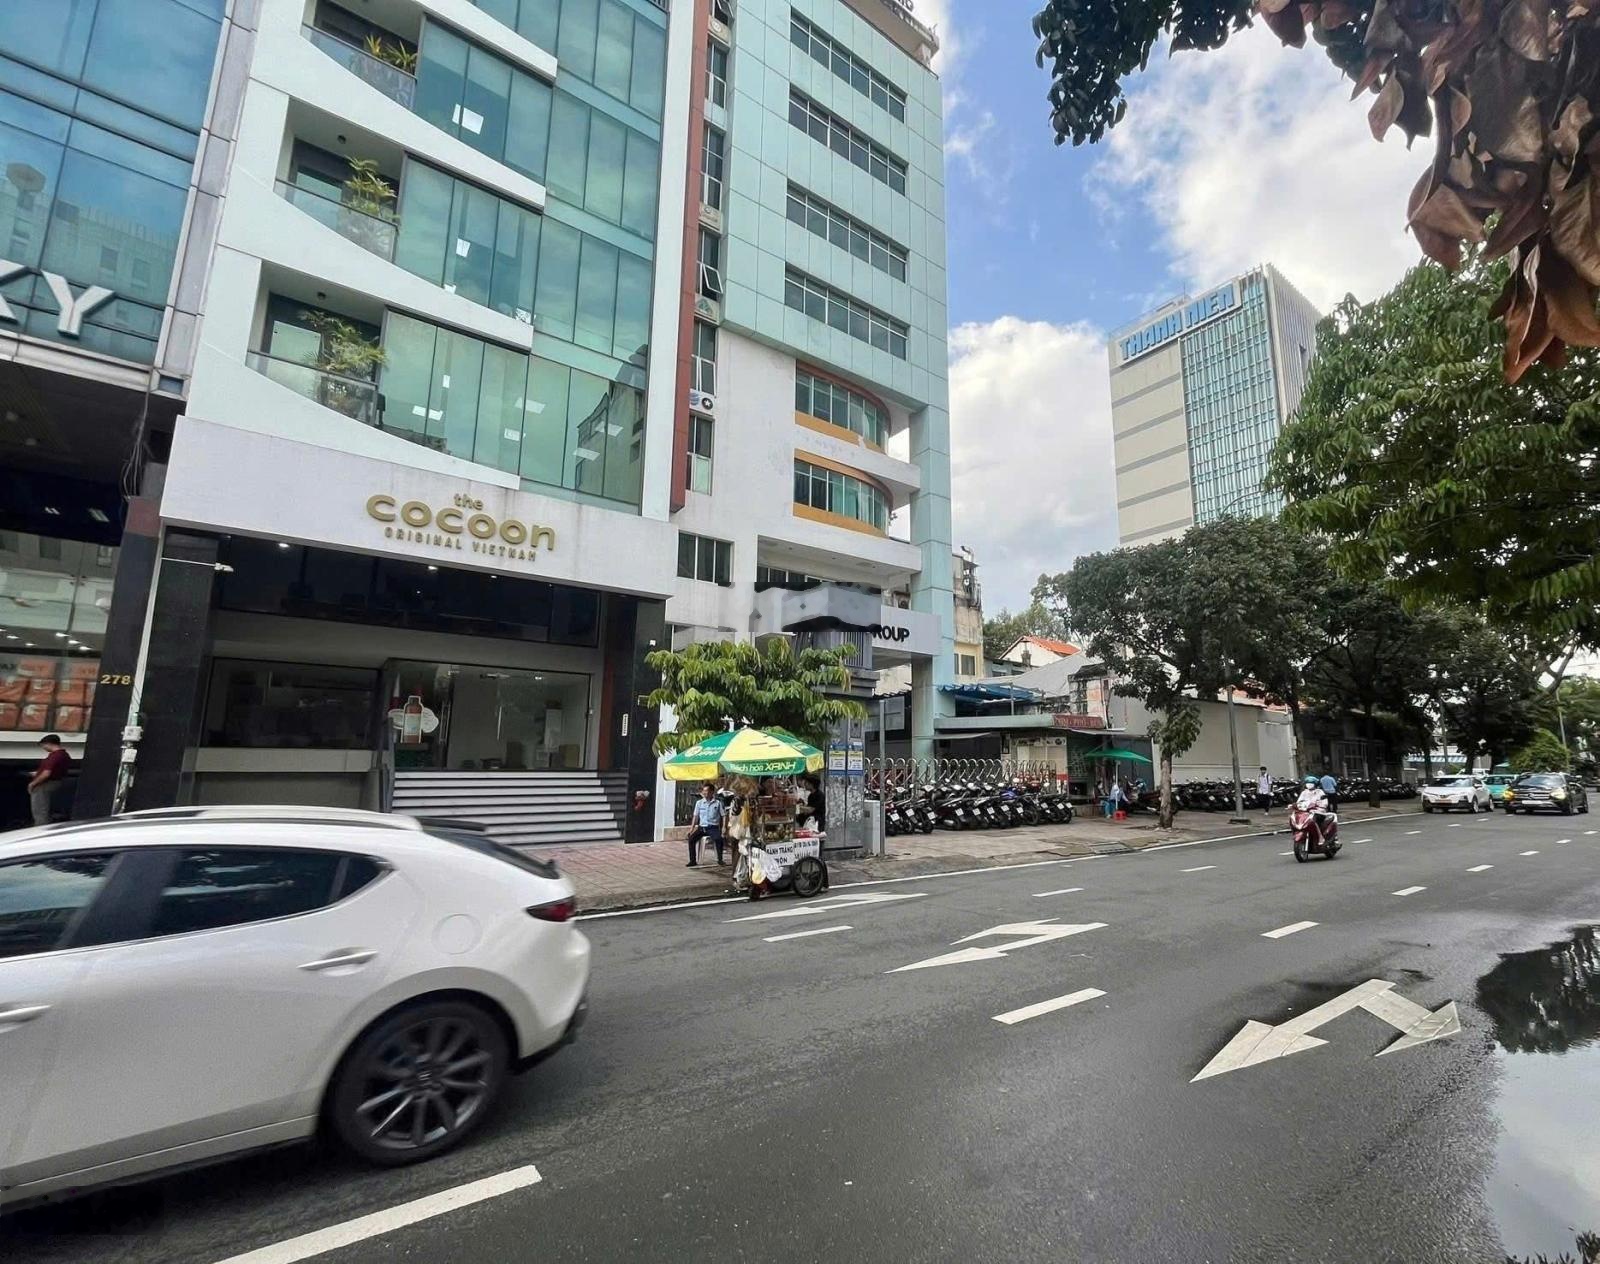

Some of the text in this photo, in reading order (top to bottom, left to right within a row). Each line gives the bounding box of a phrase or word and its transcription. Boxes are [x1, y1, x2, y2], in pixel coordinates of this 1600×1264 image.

[454, 493, 484, 510] the
[366, 494, 556, 551] cocoon
[384, 526, 537, 562] ORIGINAL VIETNAM
[871, 625, 910, 643] ROUP
[100, 674, 131, 685] 278
[764, 761, 797, 771] XANH
